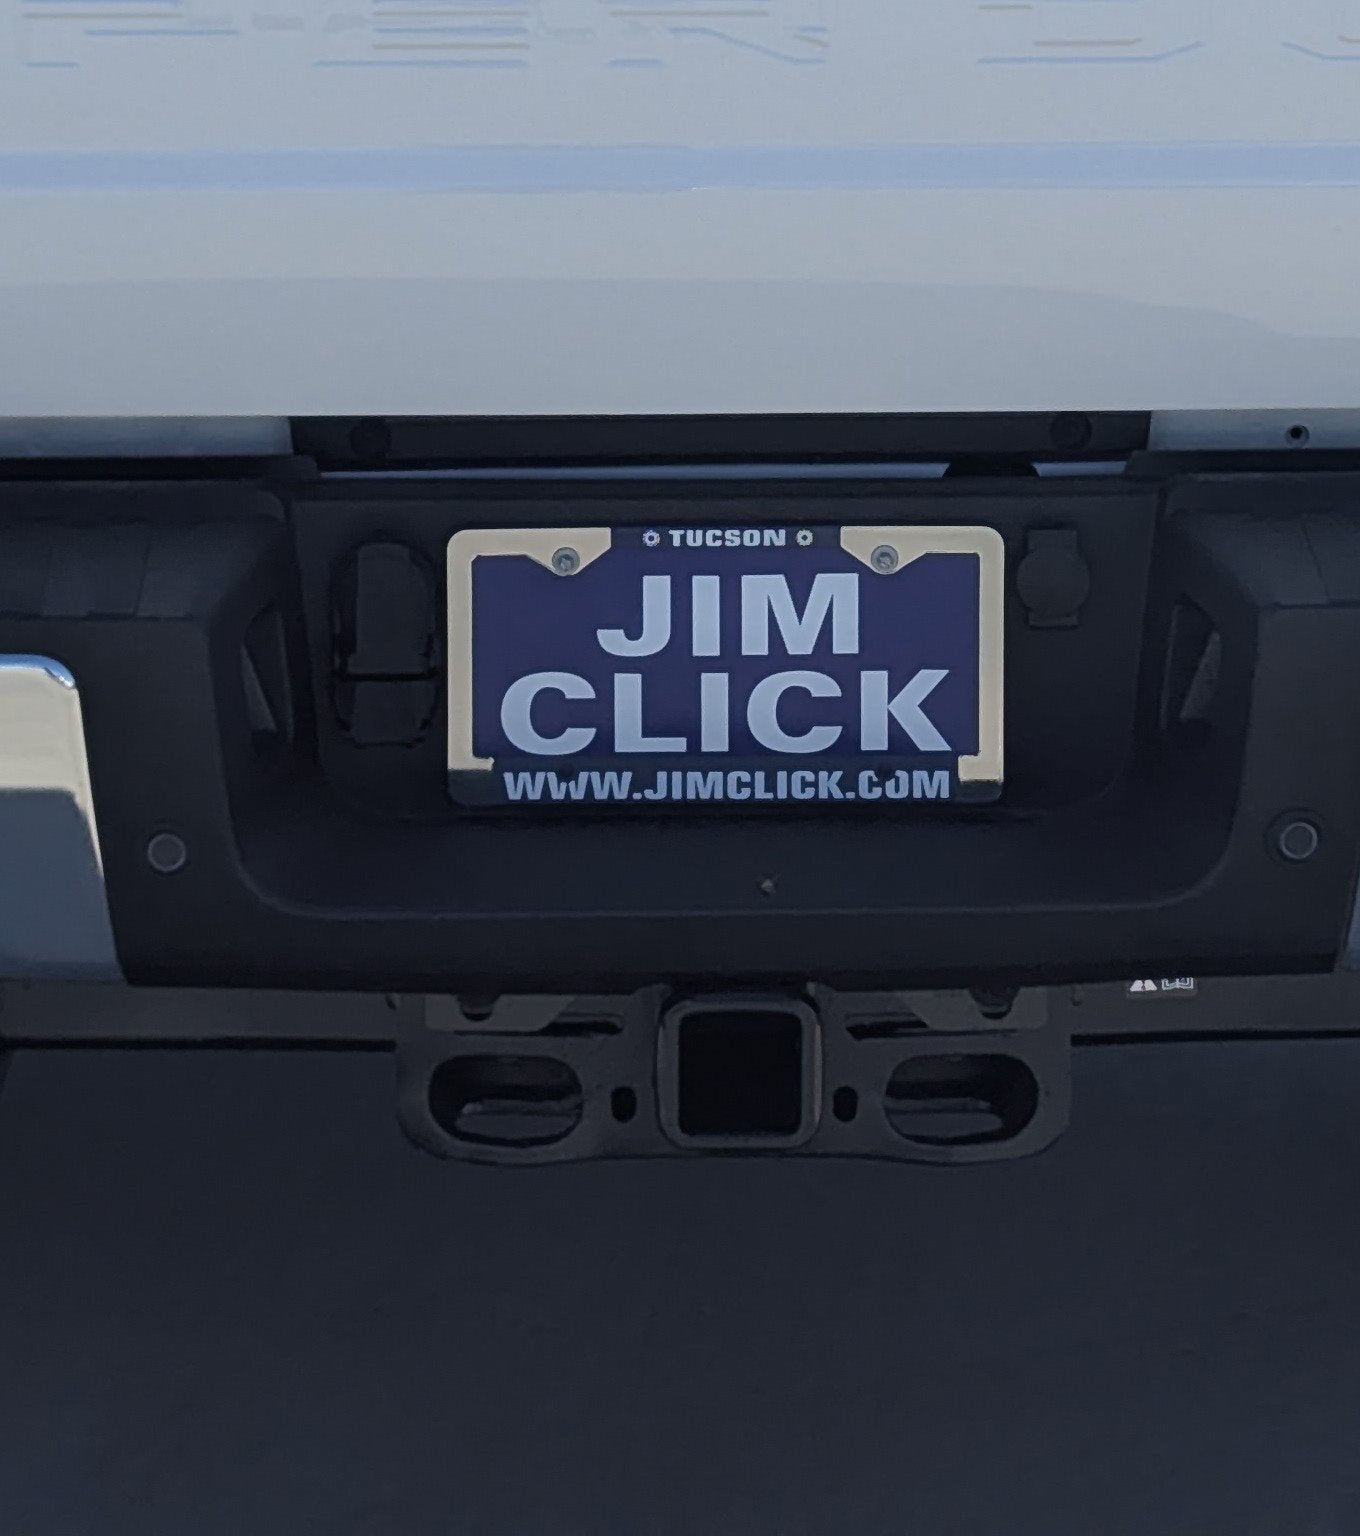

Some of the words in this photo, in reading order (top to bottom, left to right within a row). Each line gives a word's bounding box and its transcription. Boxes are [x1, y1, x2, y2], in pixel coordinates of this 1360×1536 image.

[668, 529, 786, 547] TUCSON
[596, 572, 859, 657] JIM
[500, 669, 952, 756] CLICK
[502, 769, 950, 801] WWW.JIMCLICK.COM
